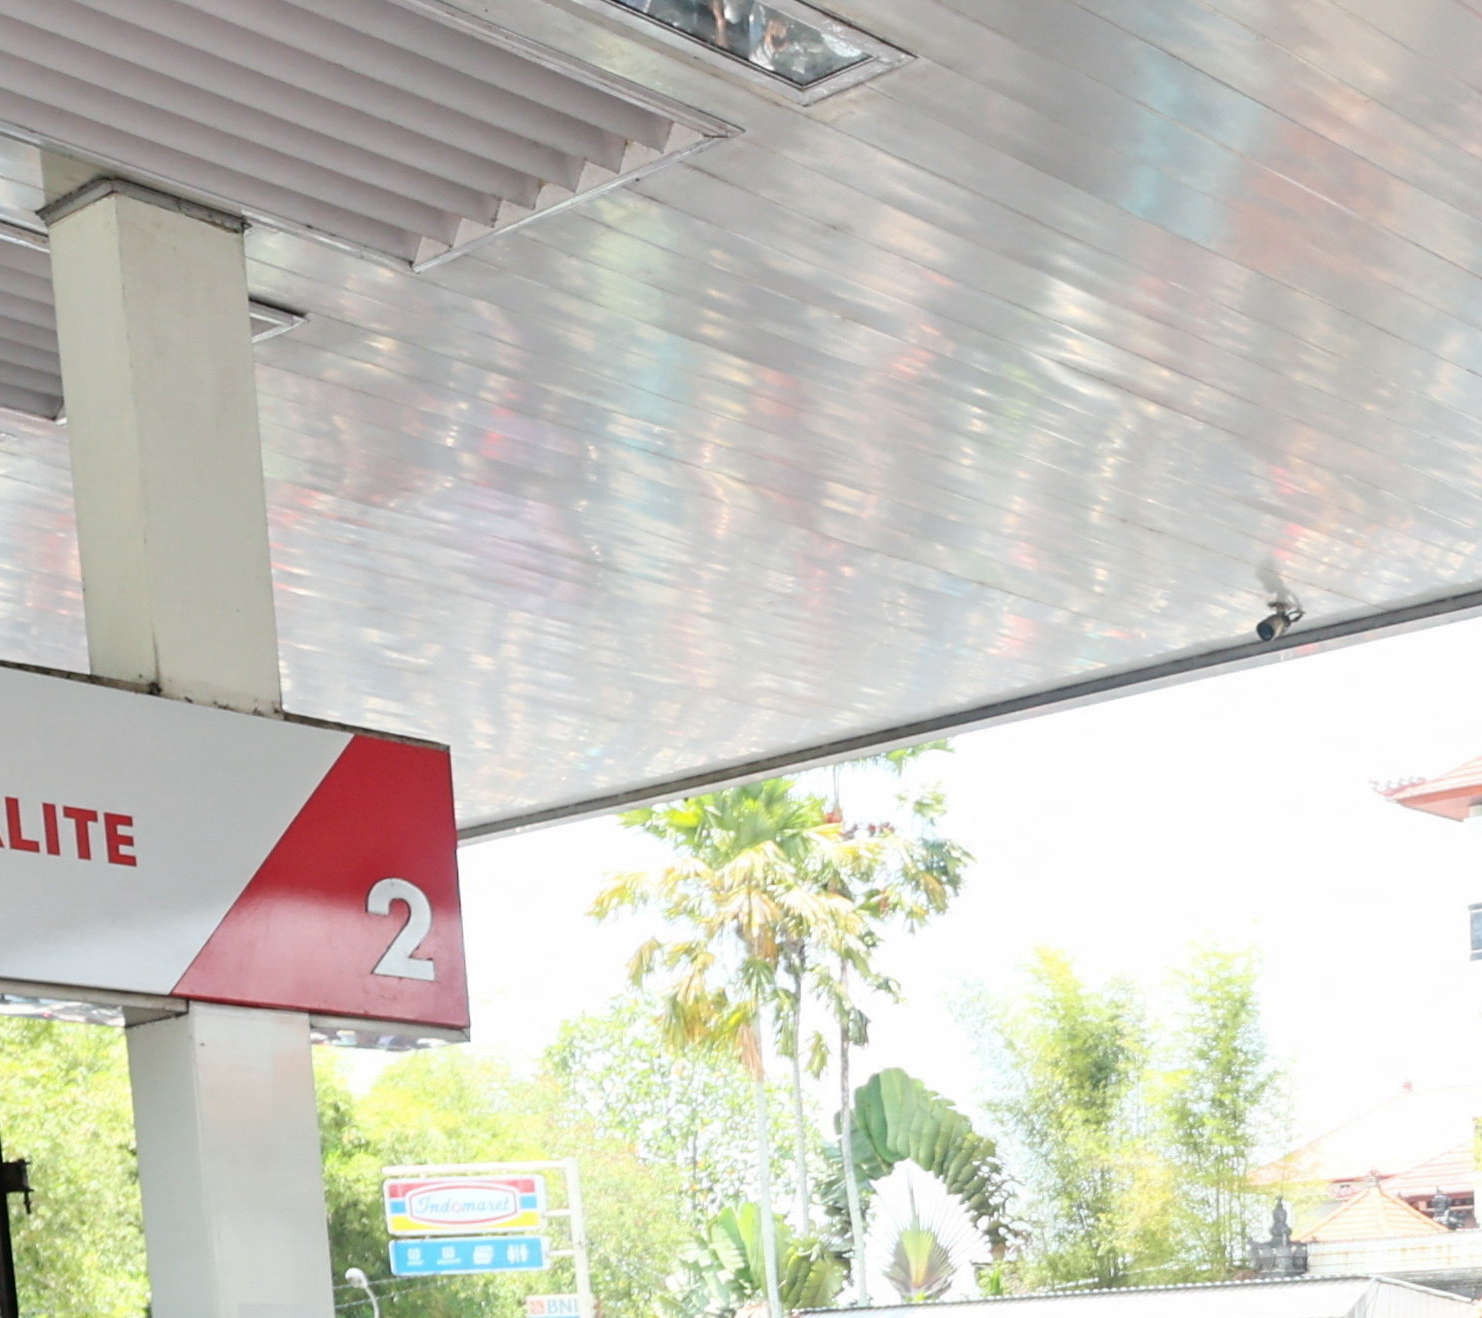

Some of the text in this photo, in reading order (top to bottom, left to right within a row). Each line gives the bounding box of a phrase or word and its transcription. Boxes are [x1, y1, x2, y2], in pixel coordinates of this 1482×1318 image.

[364, 878, 438, 983] 2
[415, 1196, 510, 1215] Indomaret
[547, 1298, 579, 1315] BNI
